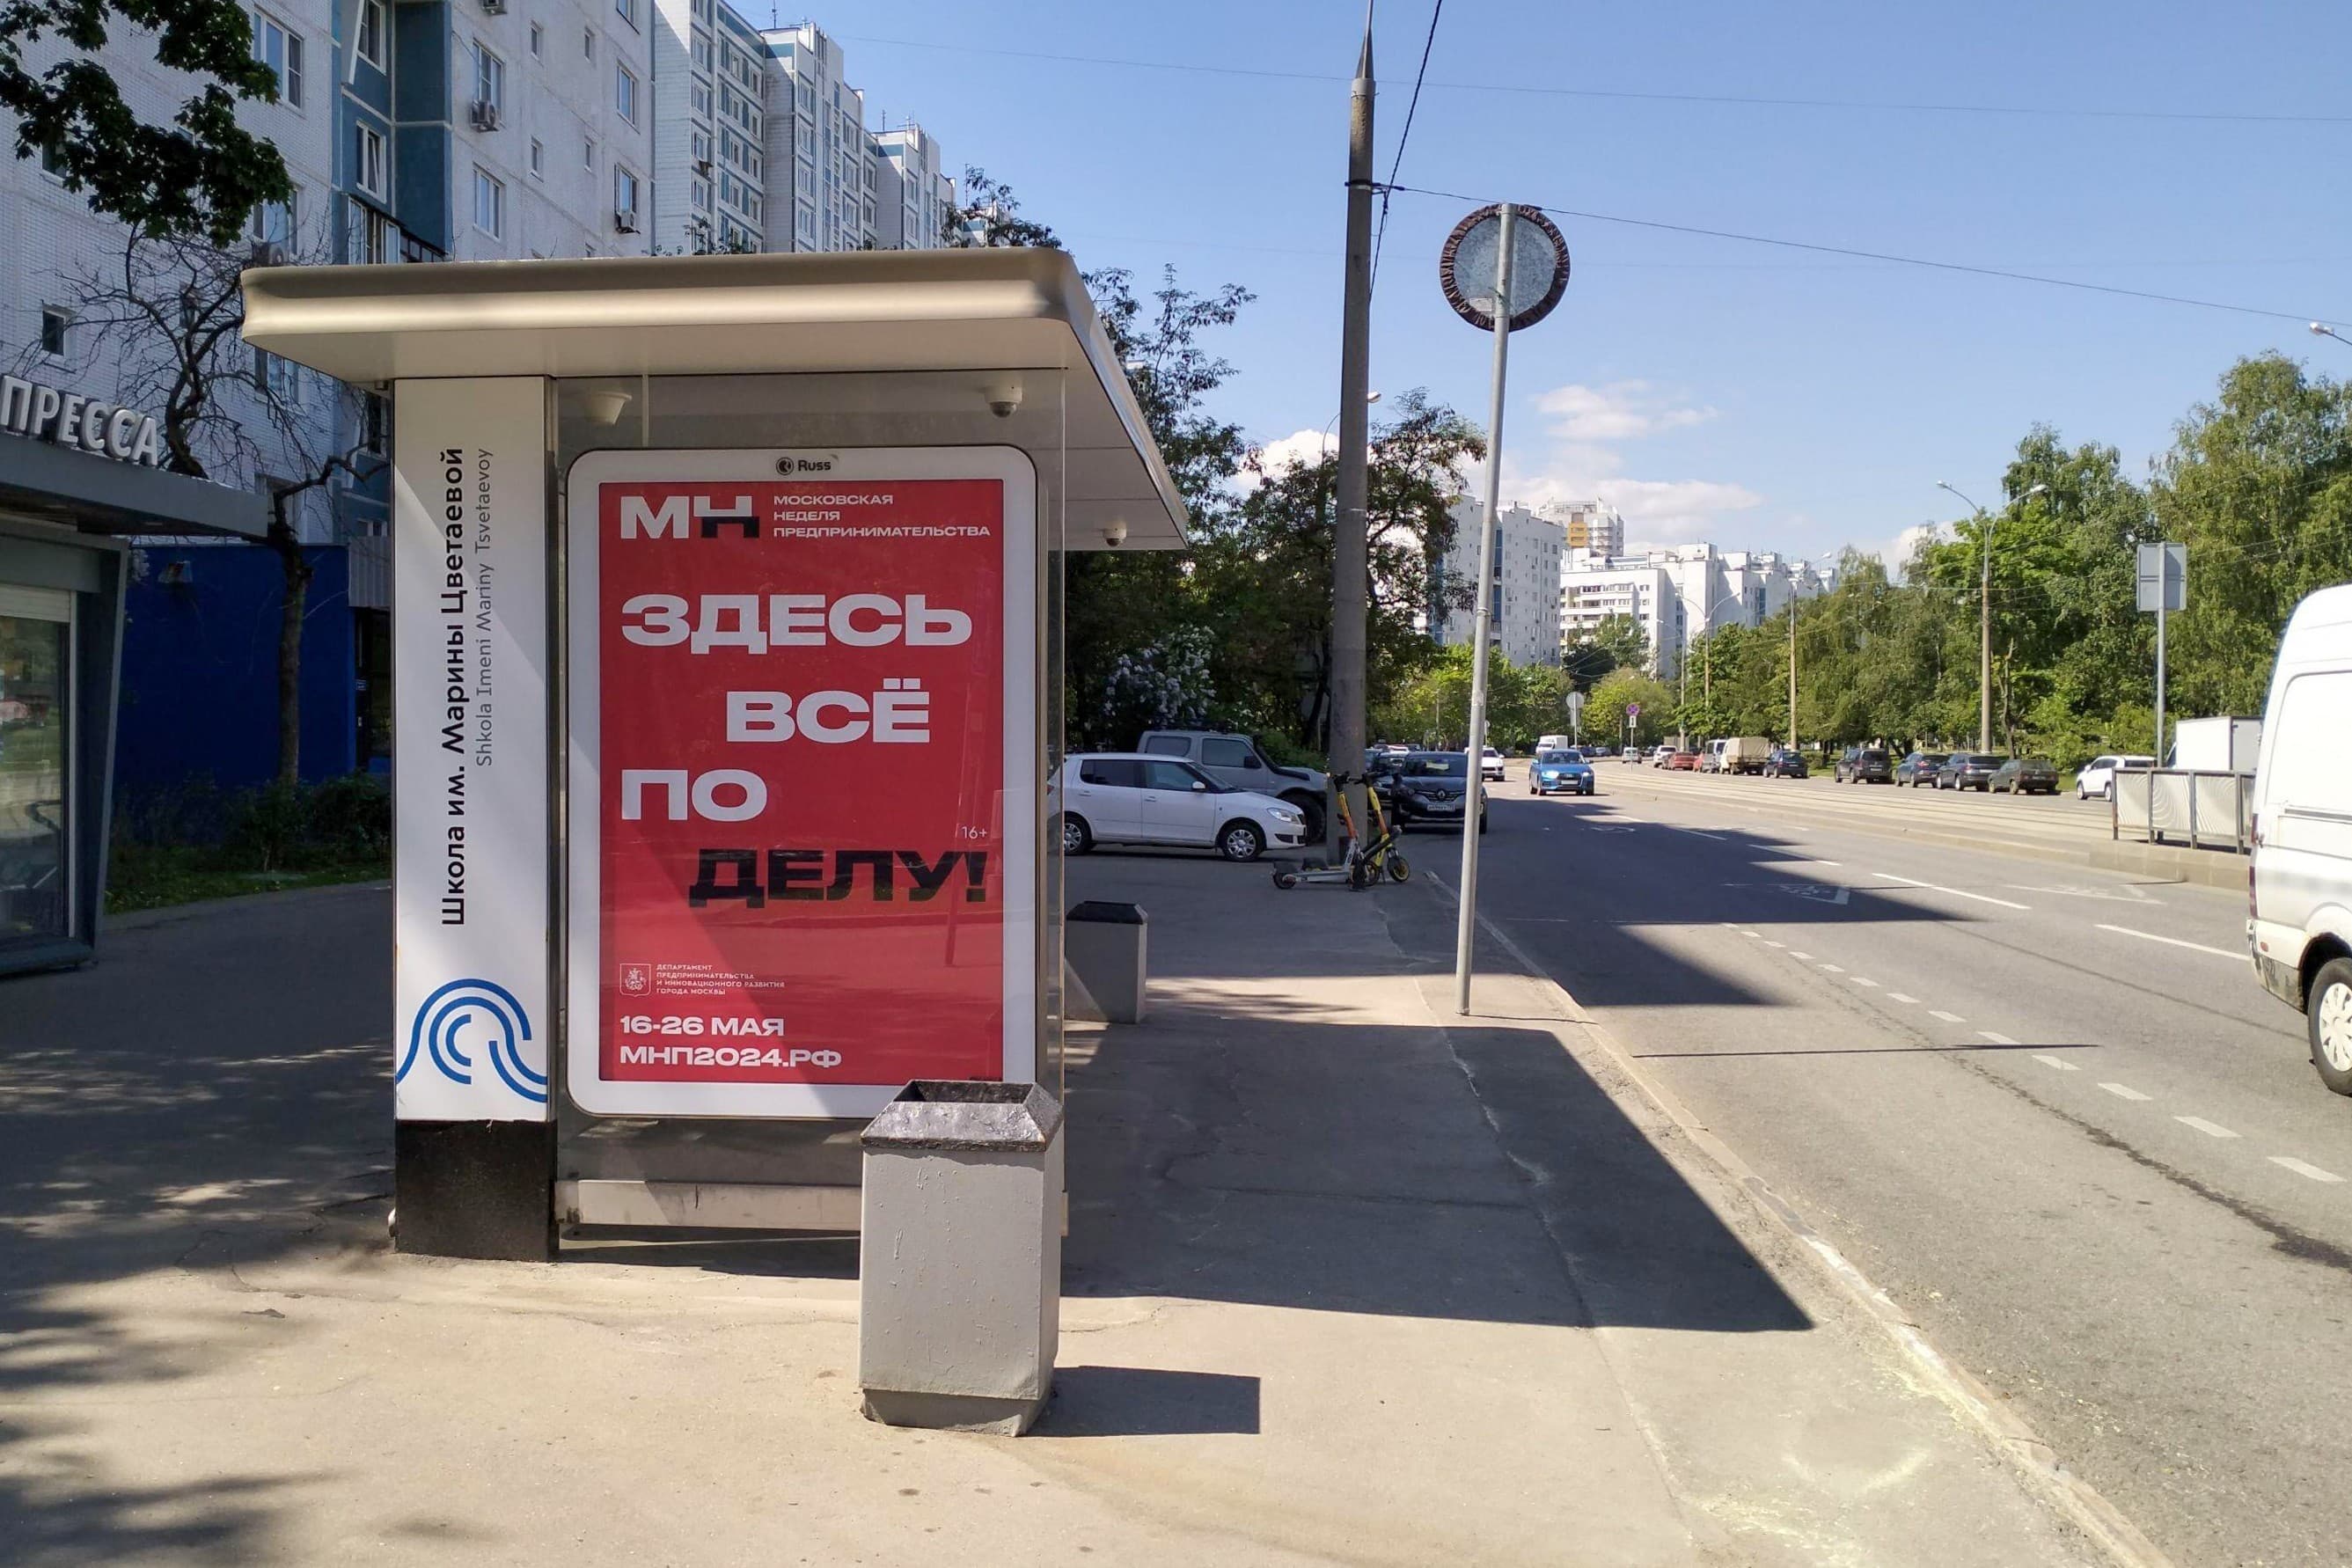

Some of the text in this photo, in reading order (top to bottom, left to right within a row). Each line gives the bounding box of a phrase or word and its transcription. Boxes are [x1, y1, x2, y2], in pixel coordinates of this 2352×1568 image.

[0, 376, 158, 465] ПРЕССА
[797, 459, 832, 472] Russ
[773, 495, 894, 505] МОСКОВСКАЯ
[773, 511, 840, 522] НЕДЕЛЯ
[773, 526, 991, 538] ПРЕДПРИНИМАТЕЛЬСТВА
[475, 448, 495, 766] Shkola Imeni Mariny Tsvetaevoy
[621, 594, 972, 655] ЗДЕСЬ
[440, 449, 470, 925] Школа им. Марины Цветаевой
[726, 678, 930, 744] ВСЁ
[621, 769, 768, 822] ПО
[962, 825, 988, 840] 16+
[689, 848, 988, 908] ДЕЛУ!
[620, 1015, 785, 1037] 16-26 МАЯ
[620, 1045, 842, 1068] МНП2024.РФ
